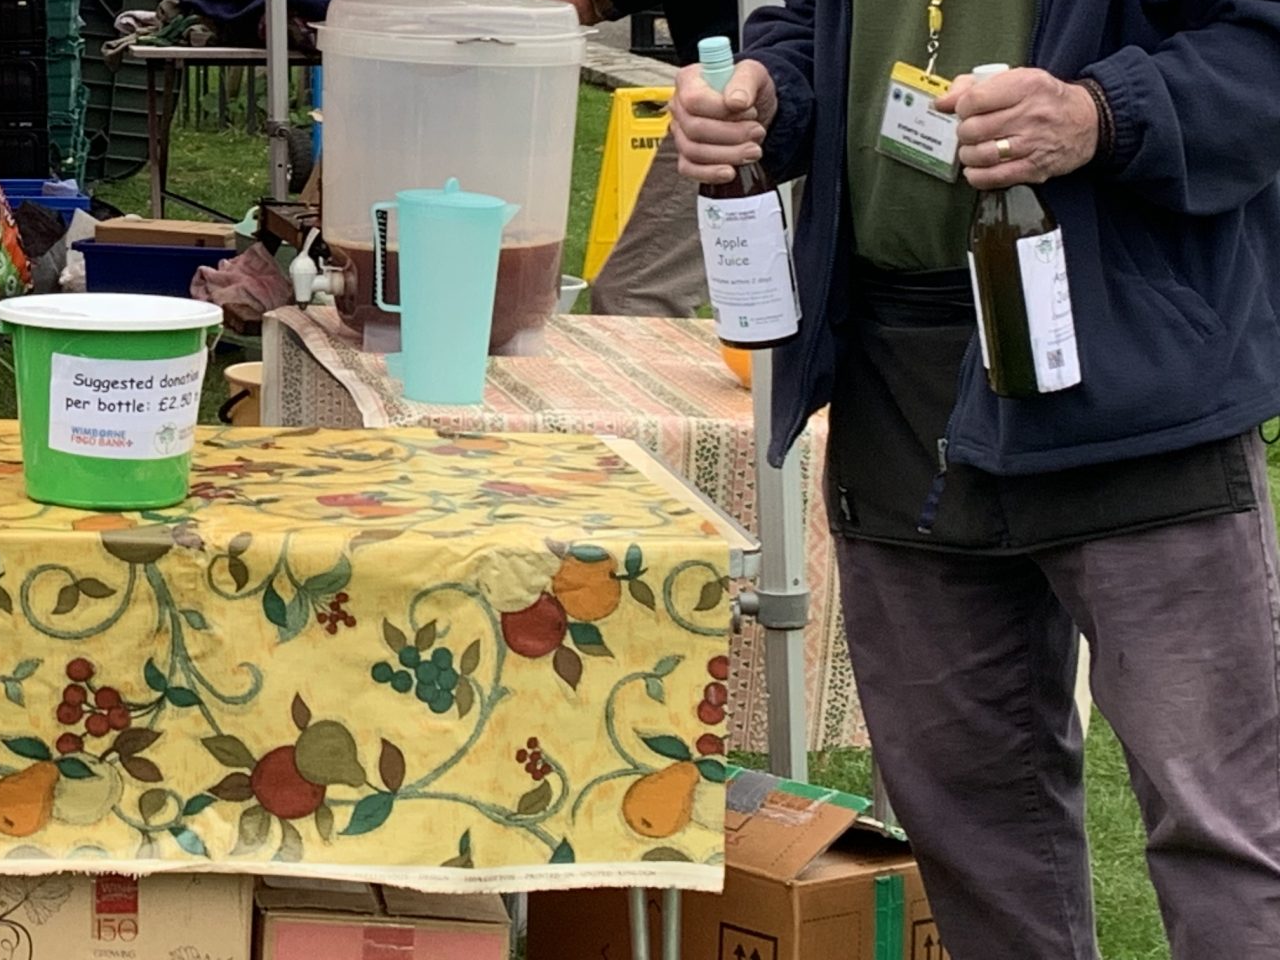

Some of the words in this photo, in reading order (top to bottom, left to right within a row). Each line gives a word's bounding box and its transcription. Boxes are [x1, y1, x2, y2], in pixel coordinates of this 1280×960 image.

[715, 237, 748, 251] Apple
[717, 255, 750, 266] Juice
[73, 373, 154, 393] Suggested
[65, 397, 91, 411] per
[97, 397, 151, 413] bottle:
[71, 426, 126, 439] WIMBORNE
